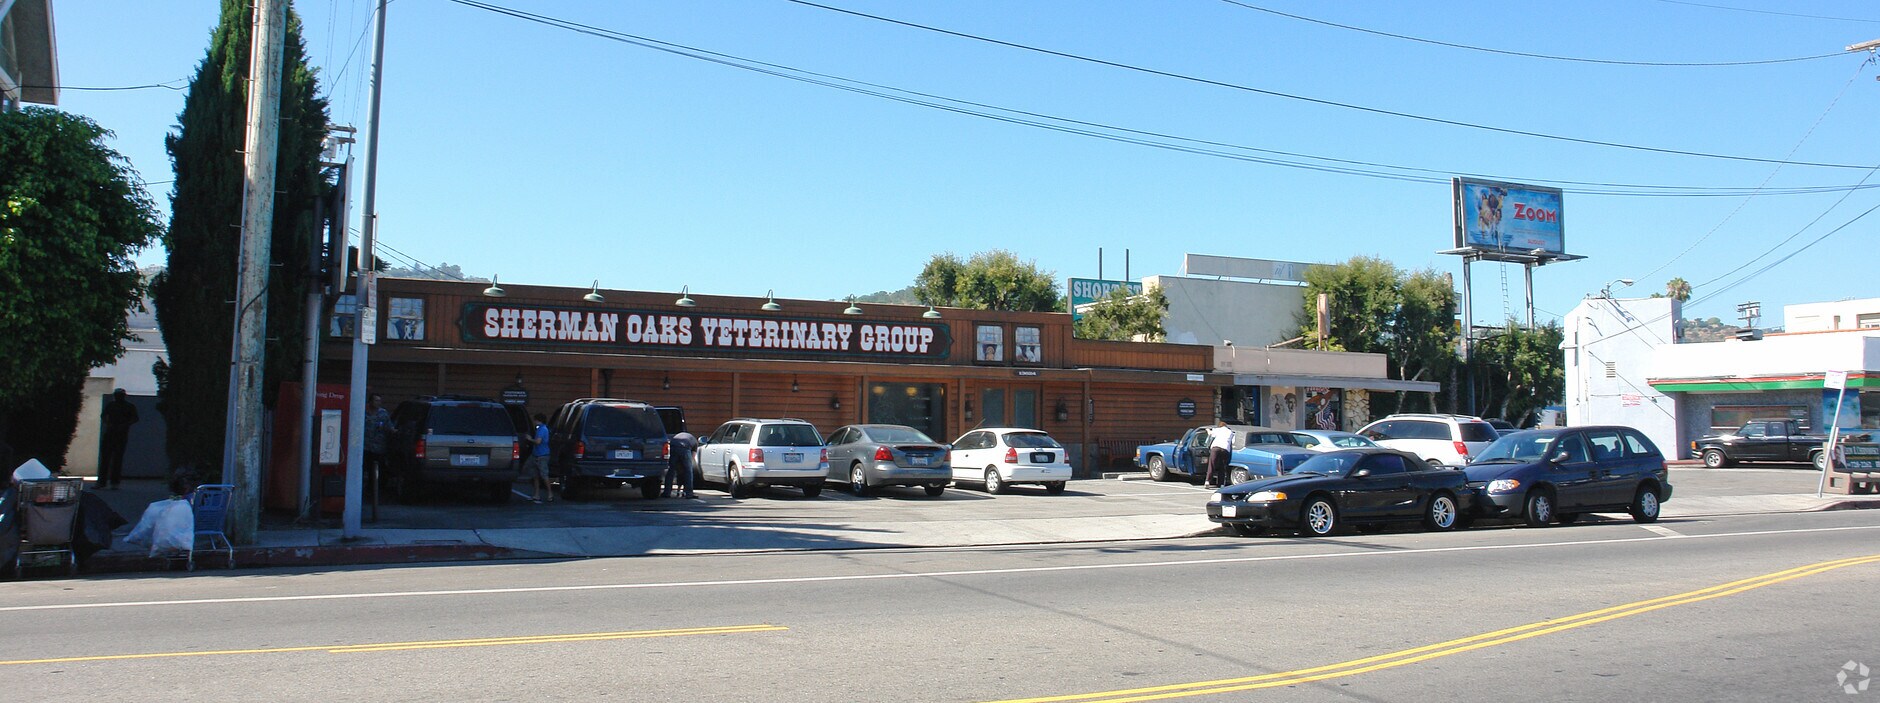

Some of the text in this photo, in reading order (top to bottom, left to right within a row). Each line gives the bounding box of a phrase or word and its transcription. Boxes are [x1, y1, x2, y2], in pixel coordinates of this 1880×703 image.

[1513, 202, 1557, 223] ZOOM
[484, 307, 935, 354] SHERMAN OAKS VETERINARY GROUP
